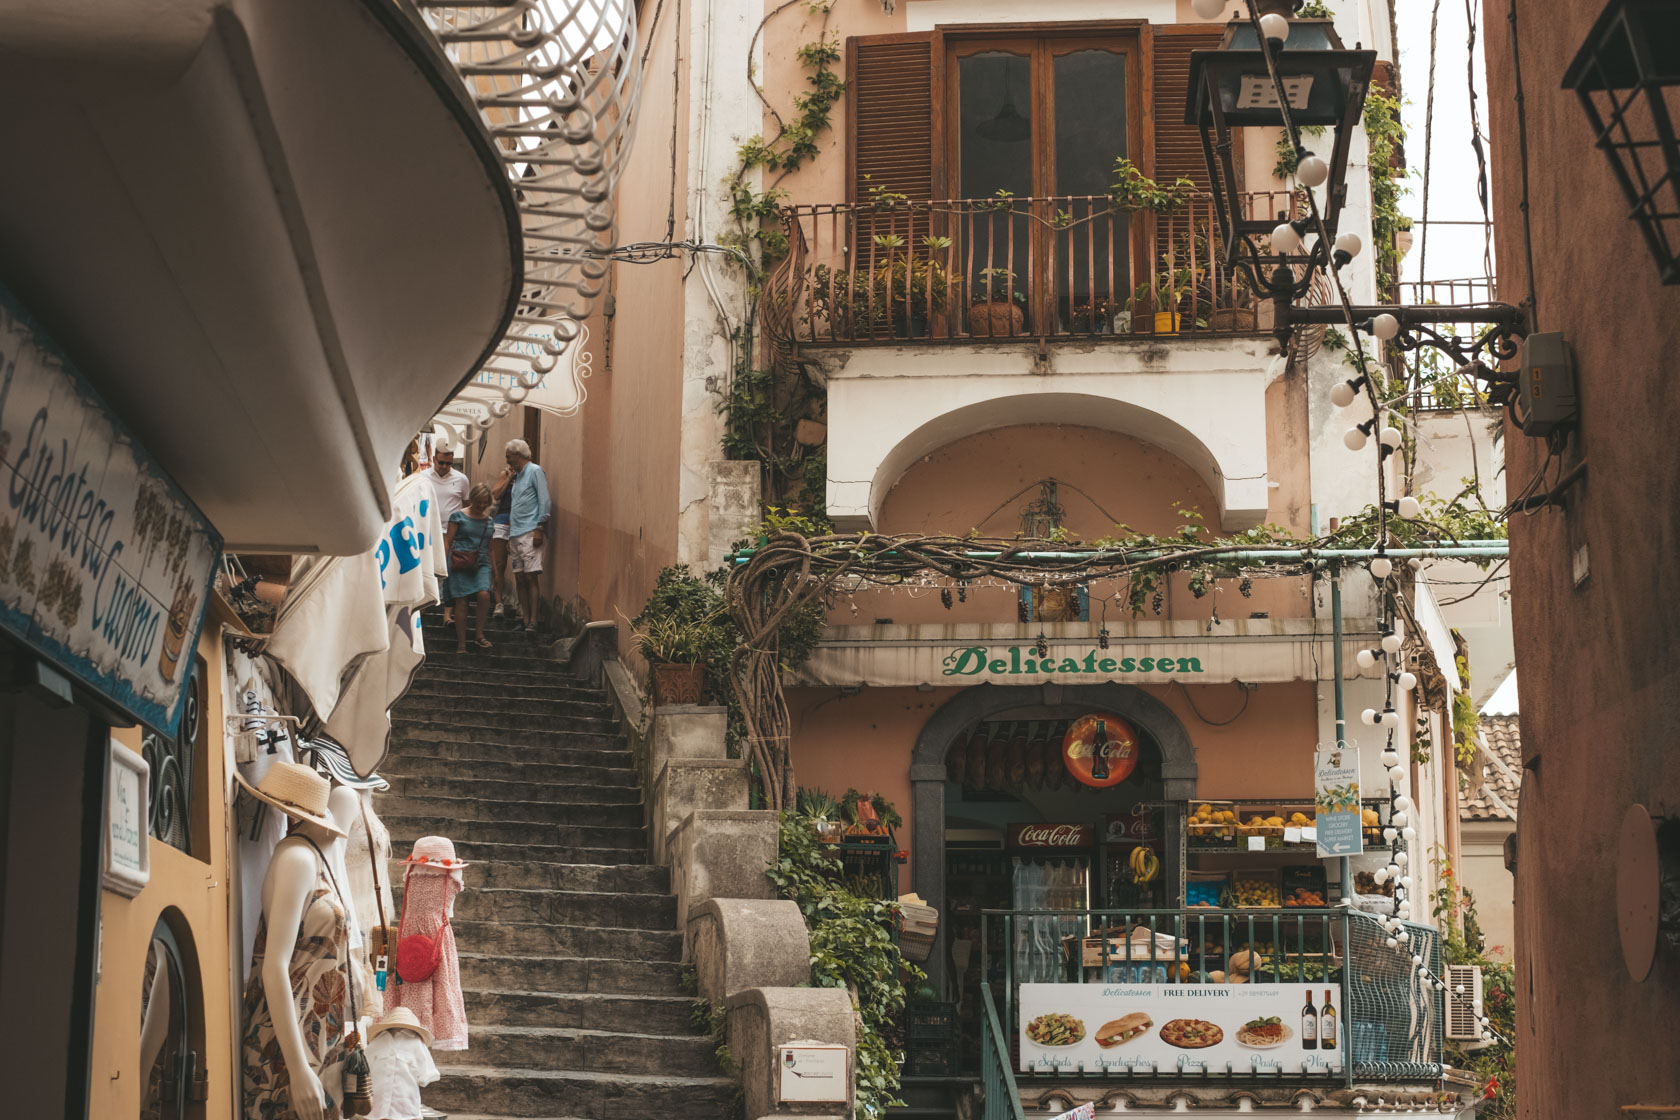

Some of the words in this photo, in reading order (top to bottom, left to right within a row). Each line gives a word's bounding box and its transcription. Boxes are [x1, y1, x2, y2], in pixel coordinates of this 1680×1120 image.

[92, 540, 161, 667] Cuomo
[942, 646, 1204, 676] Delicatessen
[1018, 824, 1083, 846] Coca-Cola
[1102, 988, 1152, 997] Delicatessen
[1164, 989, 1185, 997] FREE
[1187, 989, 1231, 997] DELIVERY
[1095, 1053, 1151, 1067] Sndwihes
